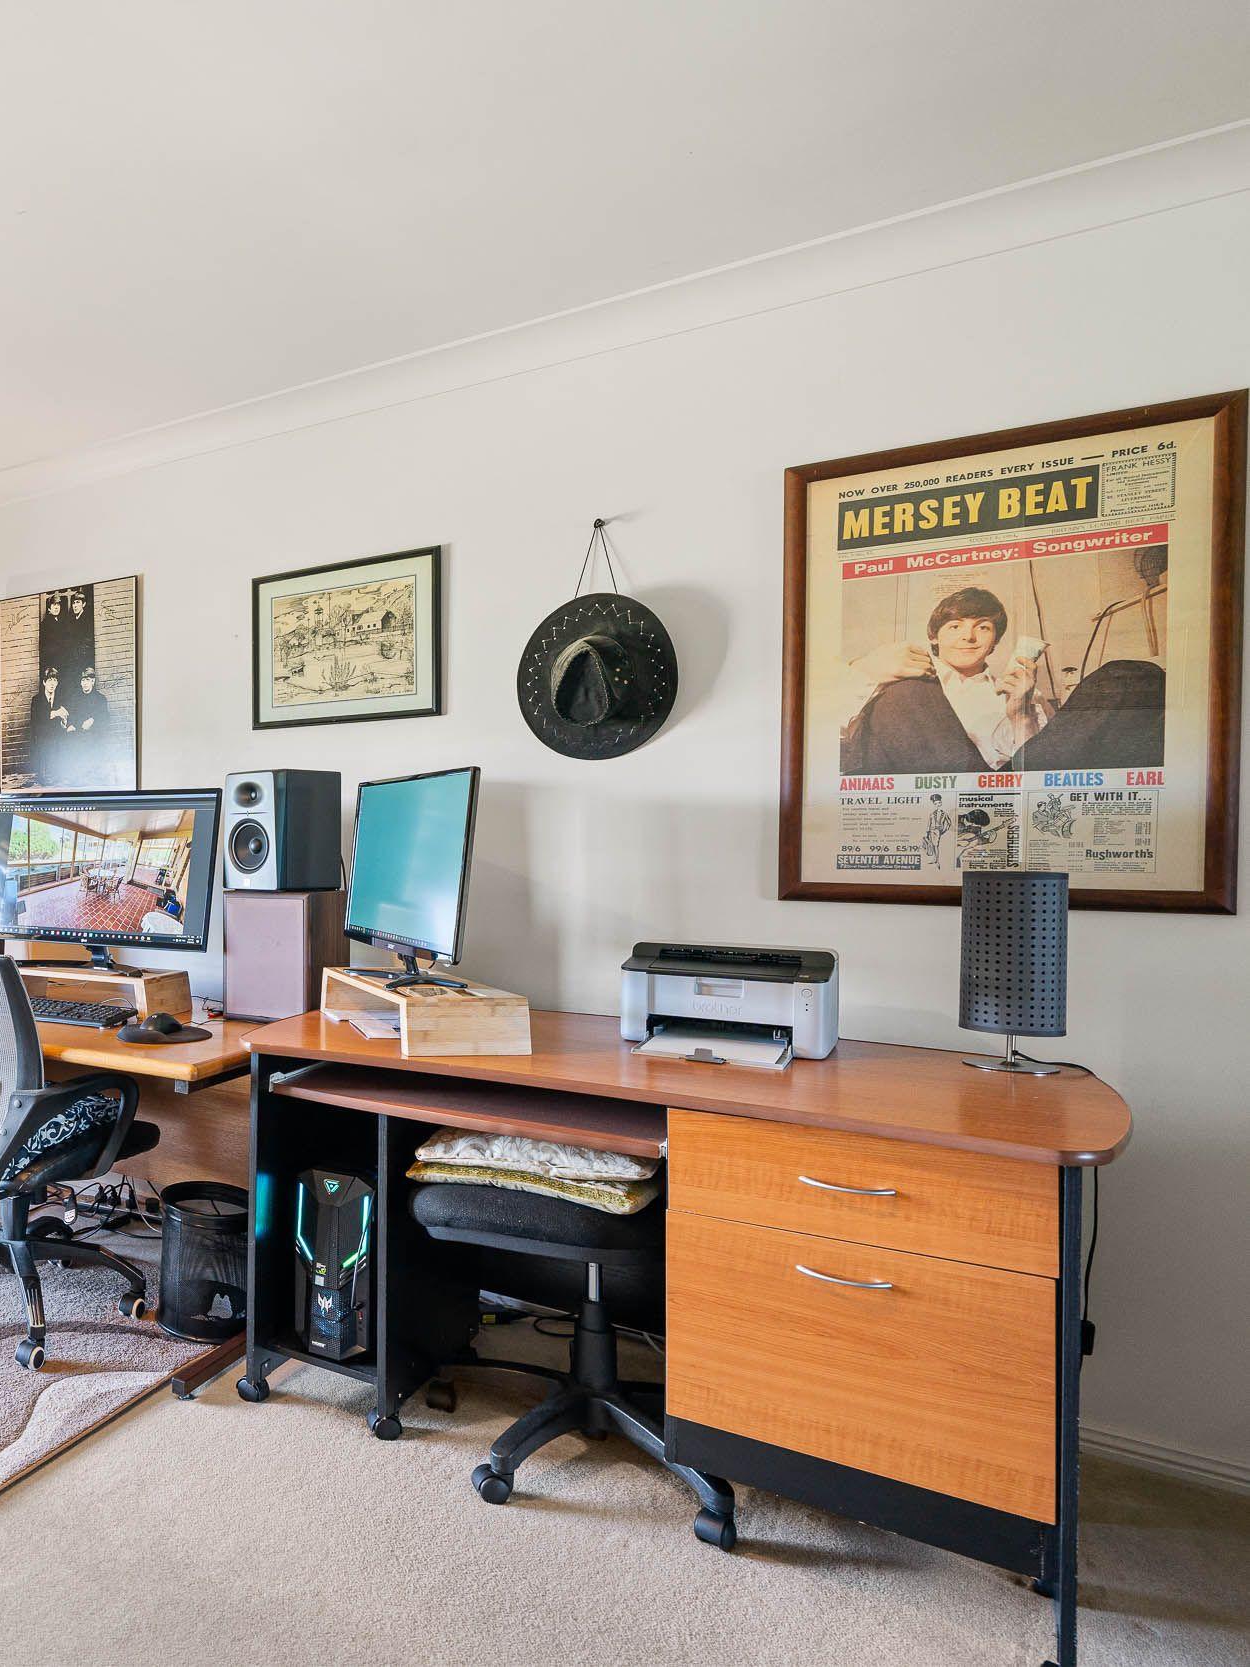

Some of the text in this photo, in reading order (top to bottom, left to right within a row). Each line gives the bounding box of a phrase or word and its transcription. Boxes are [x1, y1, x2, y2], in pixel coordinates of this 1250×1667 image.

[838, 441, 1177, 499] NOW OVER 250,000 READERS EVERY ISSUE PRICE 6d.
[1106, 457, 1172, 472] FRANK HESSY
[842, 476, 1093, 540] MERSEY BEAT
[854, 560, 894, 575] Paul
[906, 547, 1019, 569] McCartney:
[1032, 531, 1153, 554] Songwriter
[840, 771, 1165, 791] ANIMALS DUSTY GERRY BEATLES EARL
[840, 796, 922, 805] TRAVEL LIGHT
[1070, 792, 1089, 802] GET
[1094, 792, 1123, 801] WITH
[838, 855, 920, 865] SEVENTH AVENUE
[1085, 849, 1154, 860] Rushworth's
